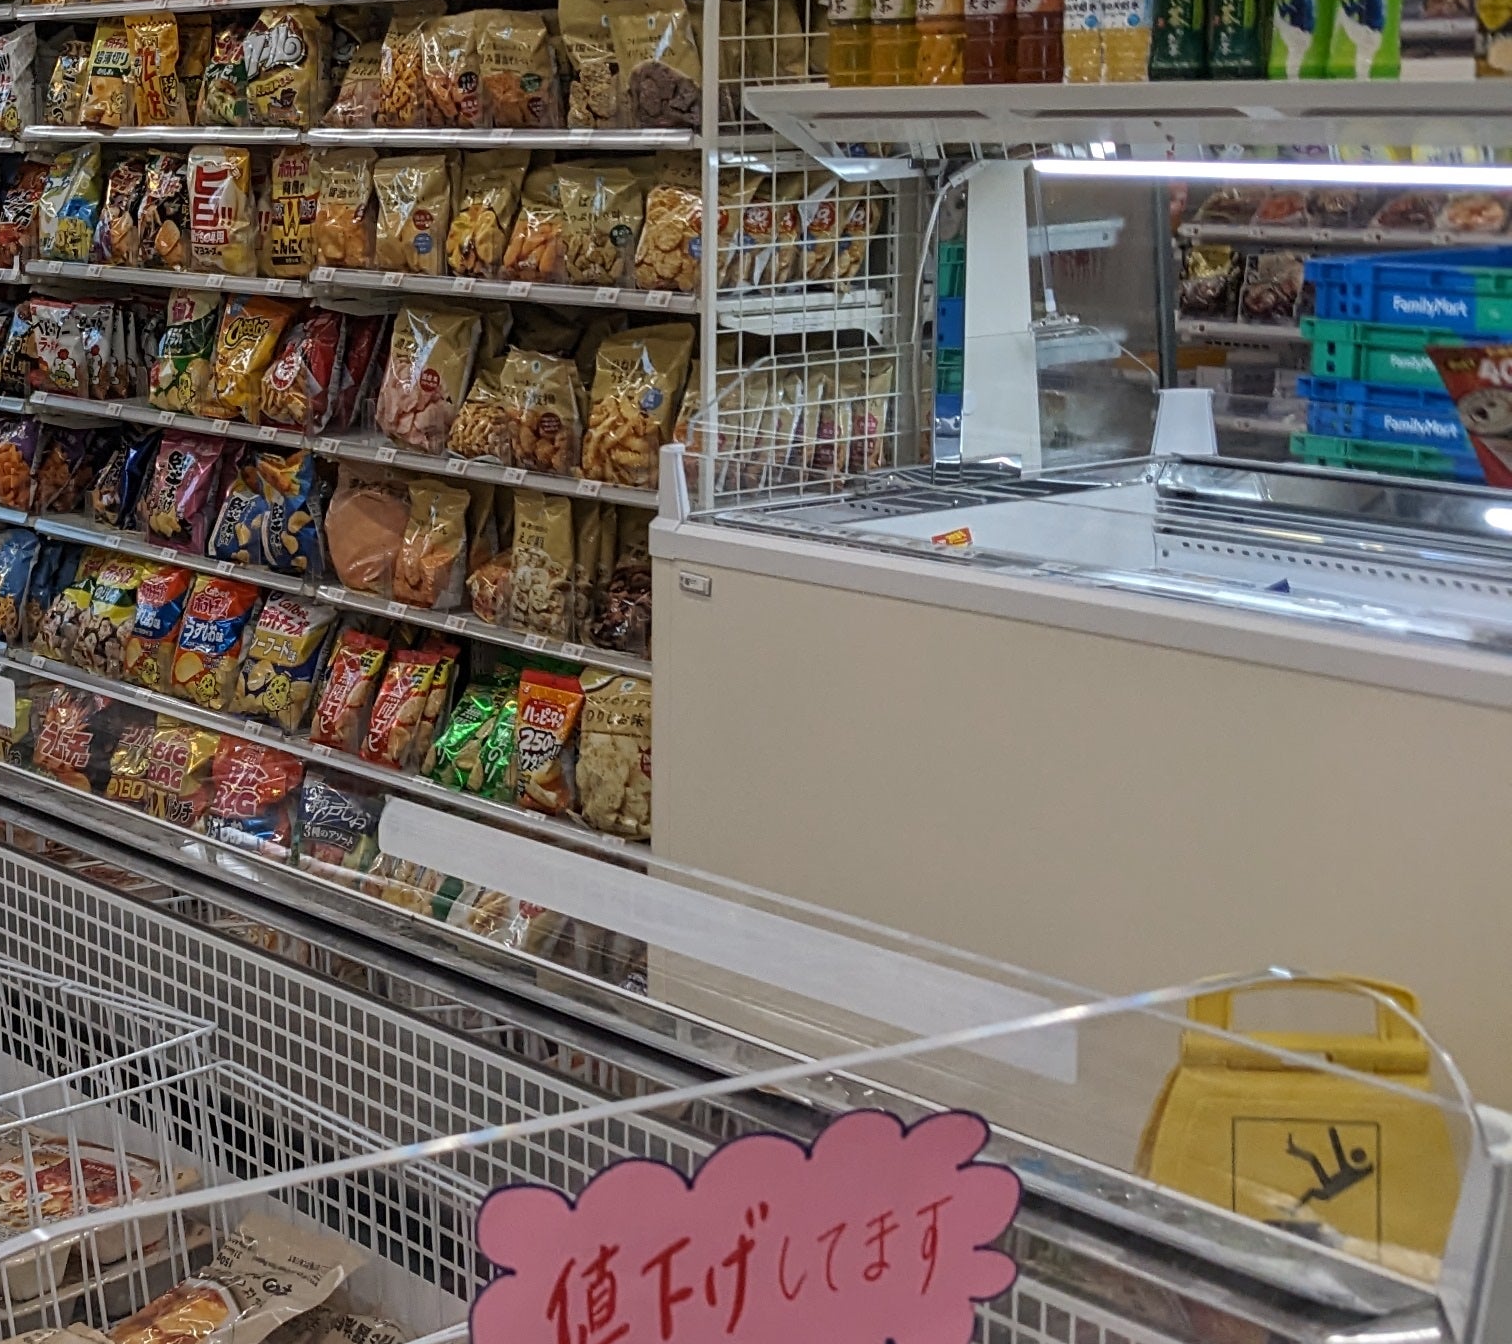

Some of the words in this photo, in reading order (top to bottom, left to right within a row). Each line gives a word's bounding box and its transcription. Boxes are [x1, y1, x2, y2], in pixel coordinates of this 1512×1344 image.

[1393, 294, 1469, 319] FamilyMart
[1383, 414, 1458, 439] FamilyMart
[181, 616, 226, 645] うすしお味
[152, 738, 190, 767] BIG
[148, 761, 184, 793] BAG
